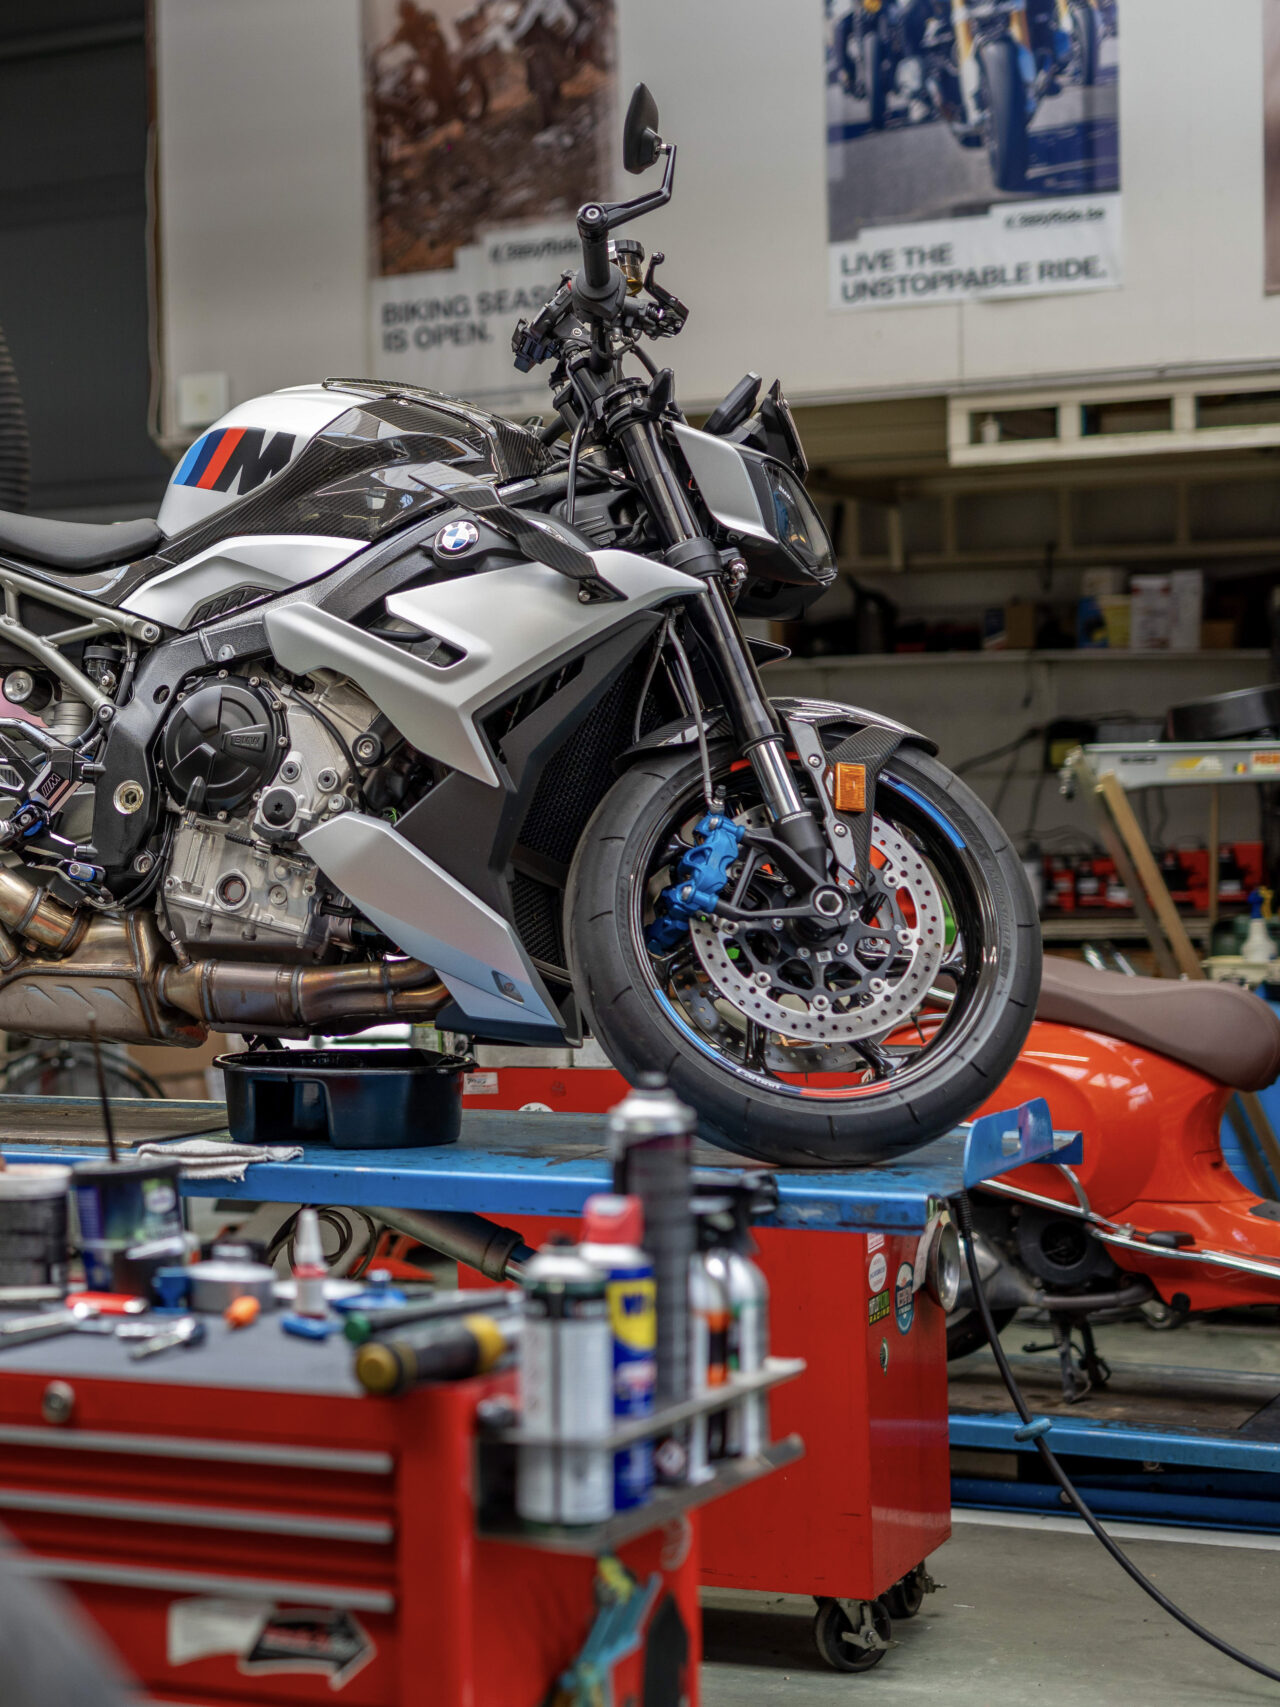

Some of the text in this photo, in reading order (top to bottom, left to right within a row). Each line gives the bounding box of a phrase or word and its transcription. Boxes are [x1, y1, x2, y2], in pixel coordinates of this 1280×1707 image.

[841, 242, 954, 275] LIVE THE
[841, 254, 1107, 302] UNSTOPPABLE RIDE.
[381, 293, 470, 326] BIKING
[381, 320, 494, 352] IS OPEN.
[234, 735, 261, 745] BMW
